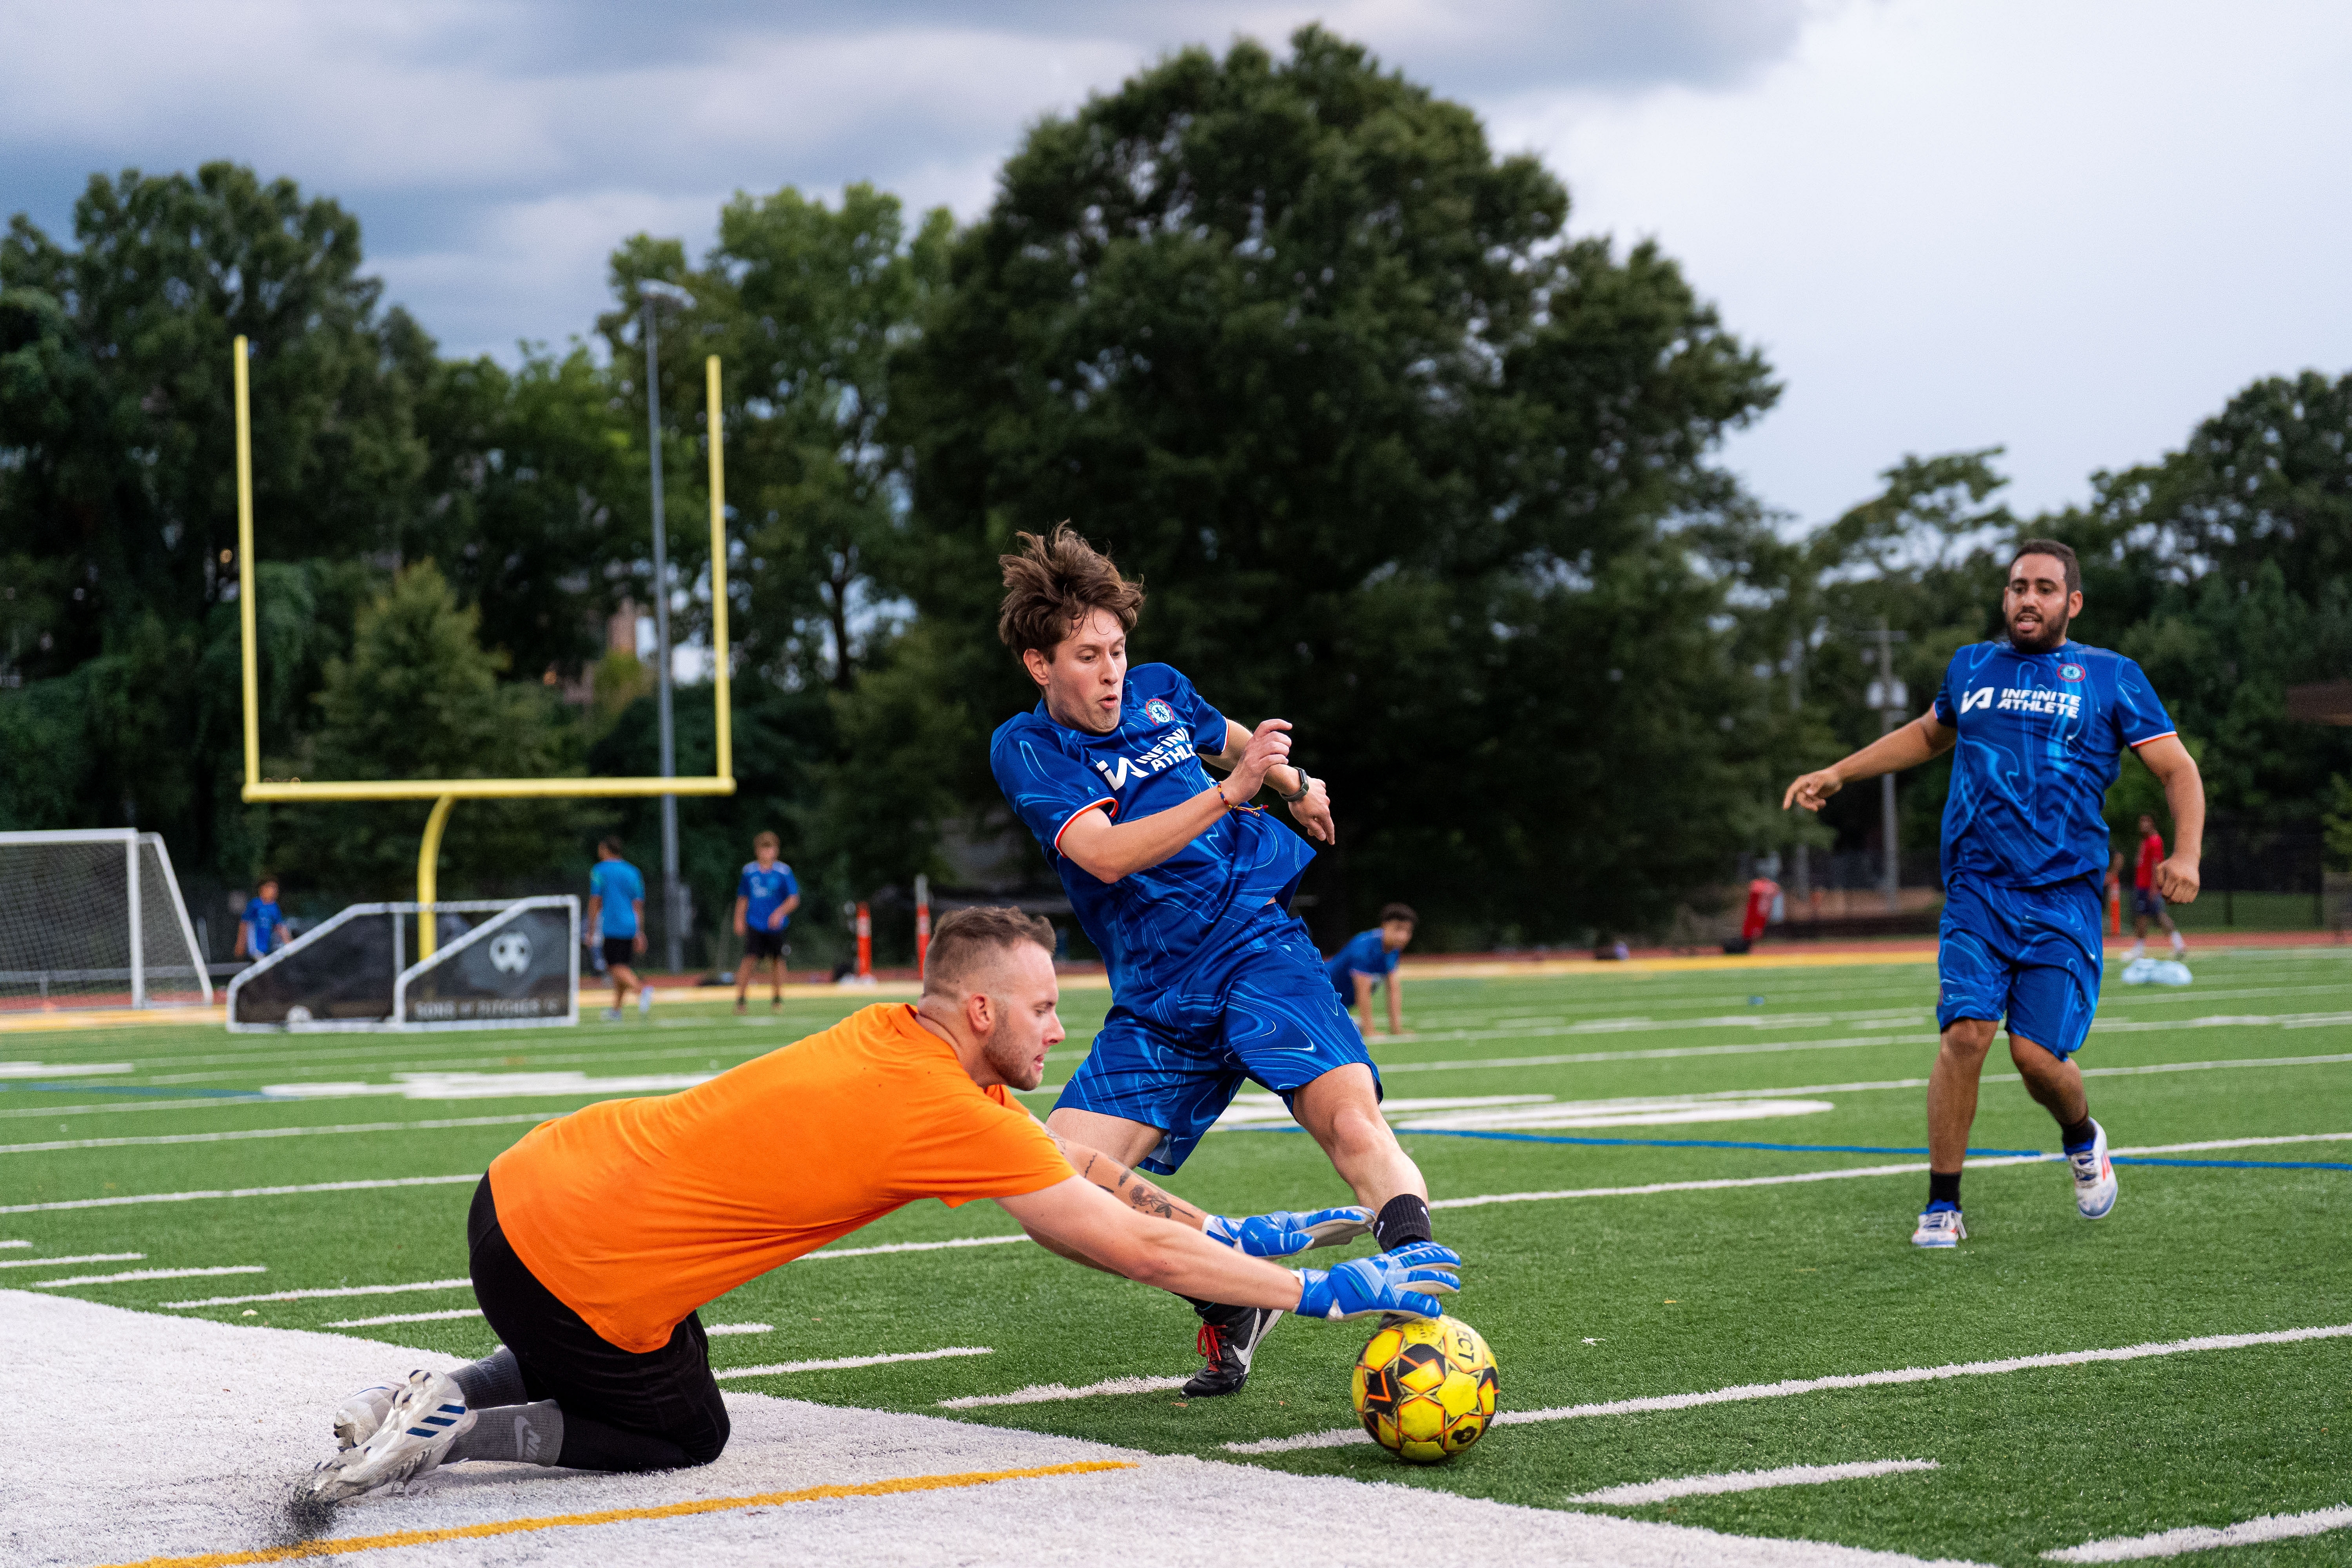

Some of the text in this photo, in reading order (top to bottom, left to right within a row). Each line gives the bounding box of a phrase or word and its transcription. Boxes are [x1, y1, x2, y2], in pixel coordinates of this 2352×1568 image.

[2000, 688, 2081, 706] INFINITE
[1148, 701, 1160, 713] CHELSEA
[1996, 698, 2079, 719] ATHLETE
